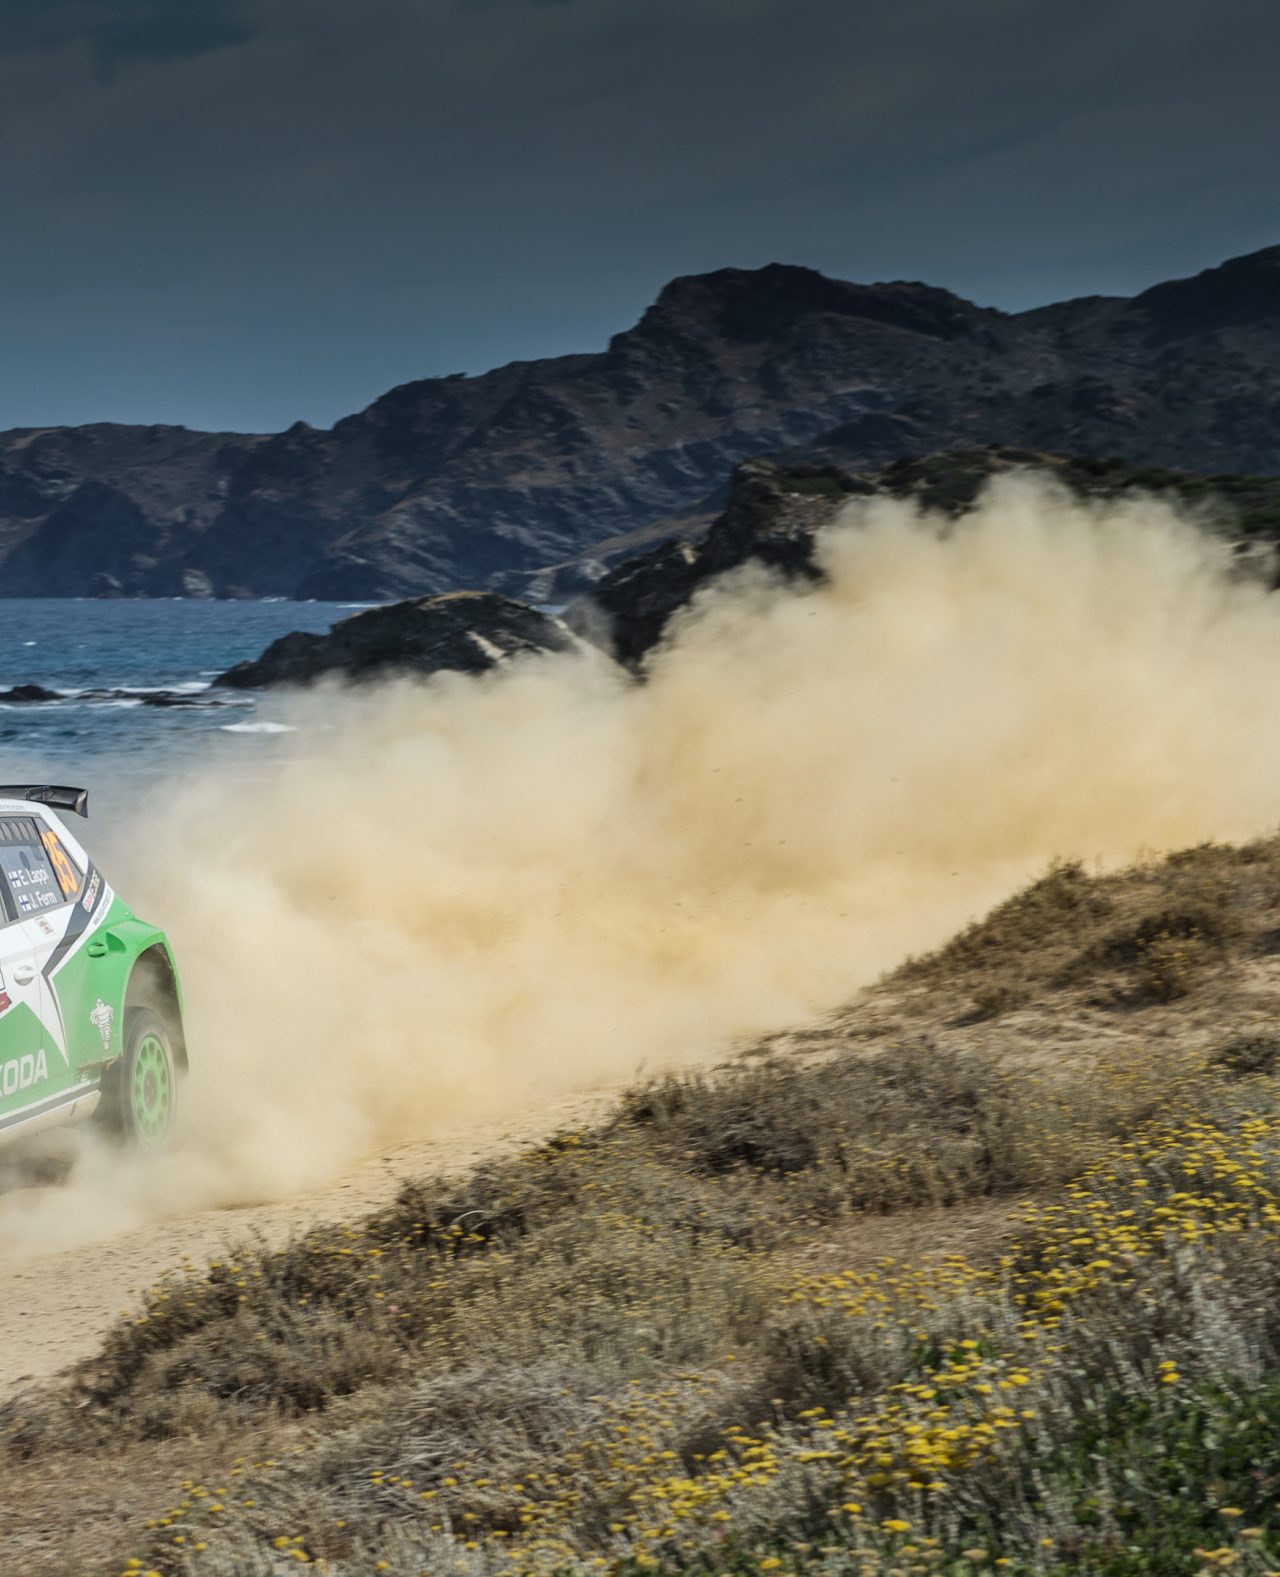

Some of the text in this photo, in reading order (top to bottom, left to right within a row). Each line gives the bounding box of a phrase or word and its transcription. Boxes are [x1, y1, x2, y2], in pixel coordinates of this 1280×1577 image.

[40, 831, 79, 894] 35
[26, 864, 49, 886] Lappi
[35, 891, 58, 907] Ferm
